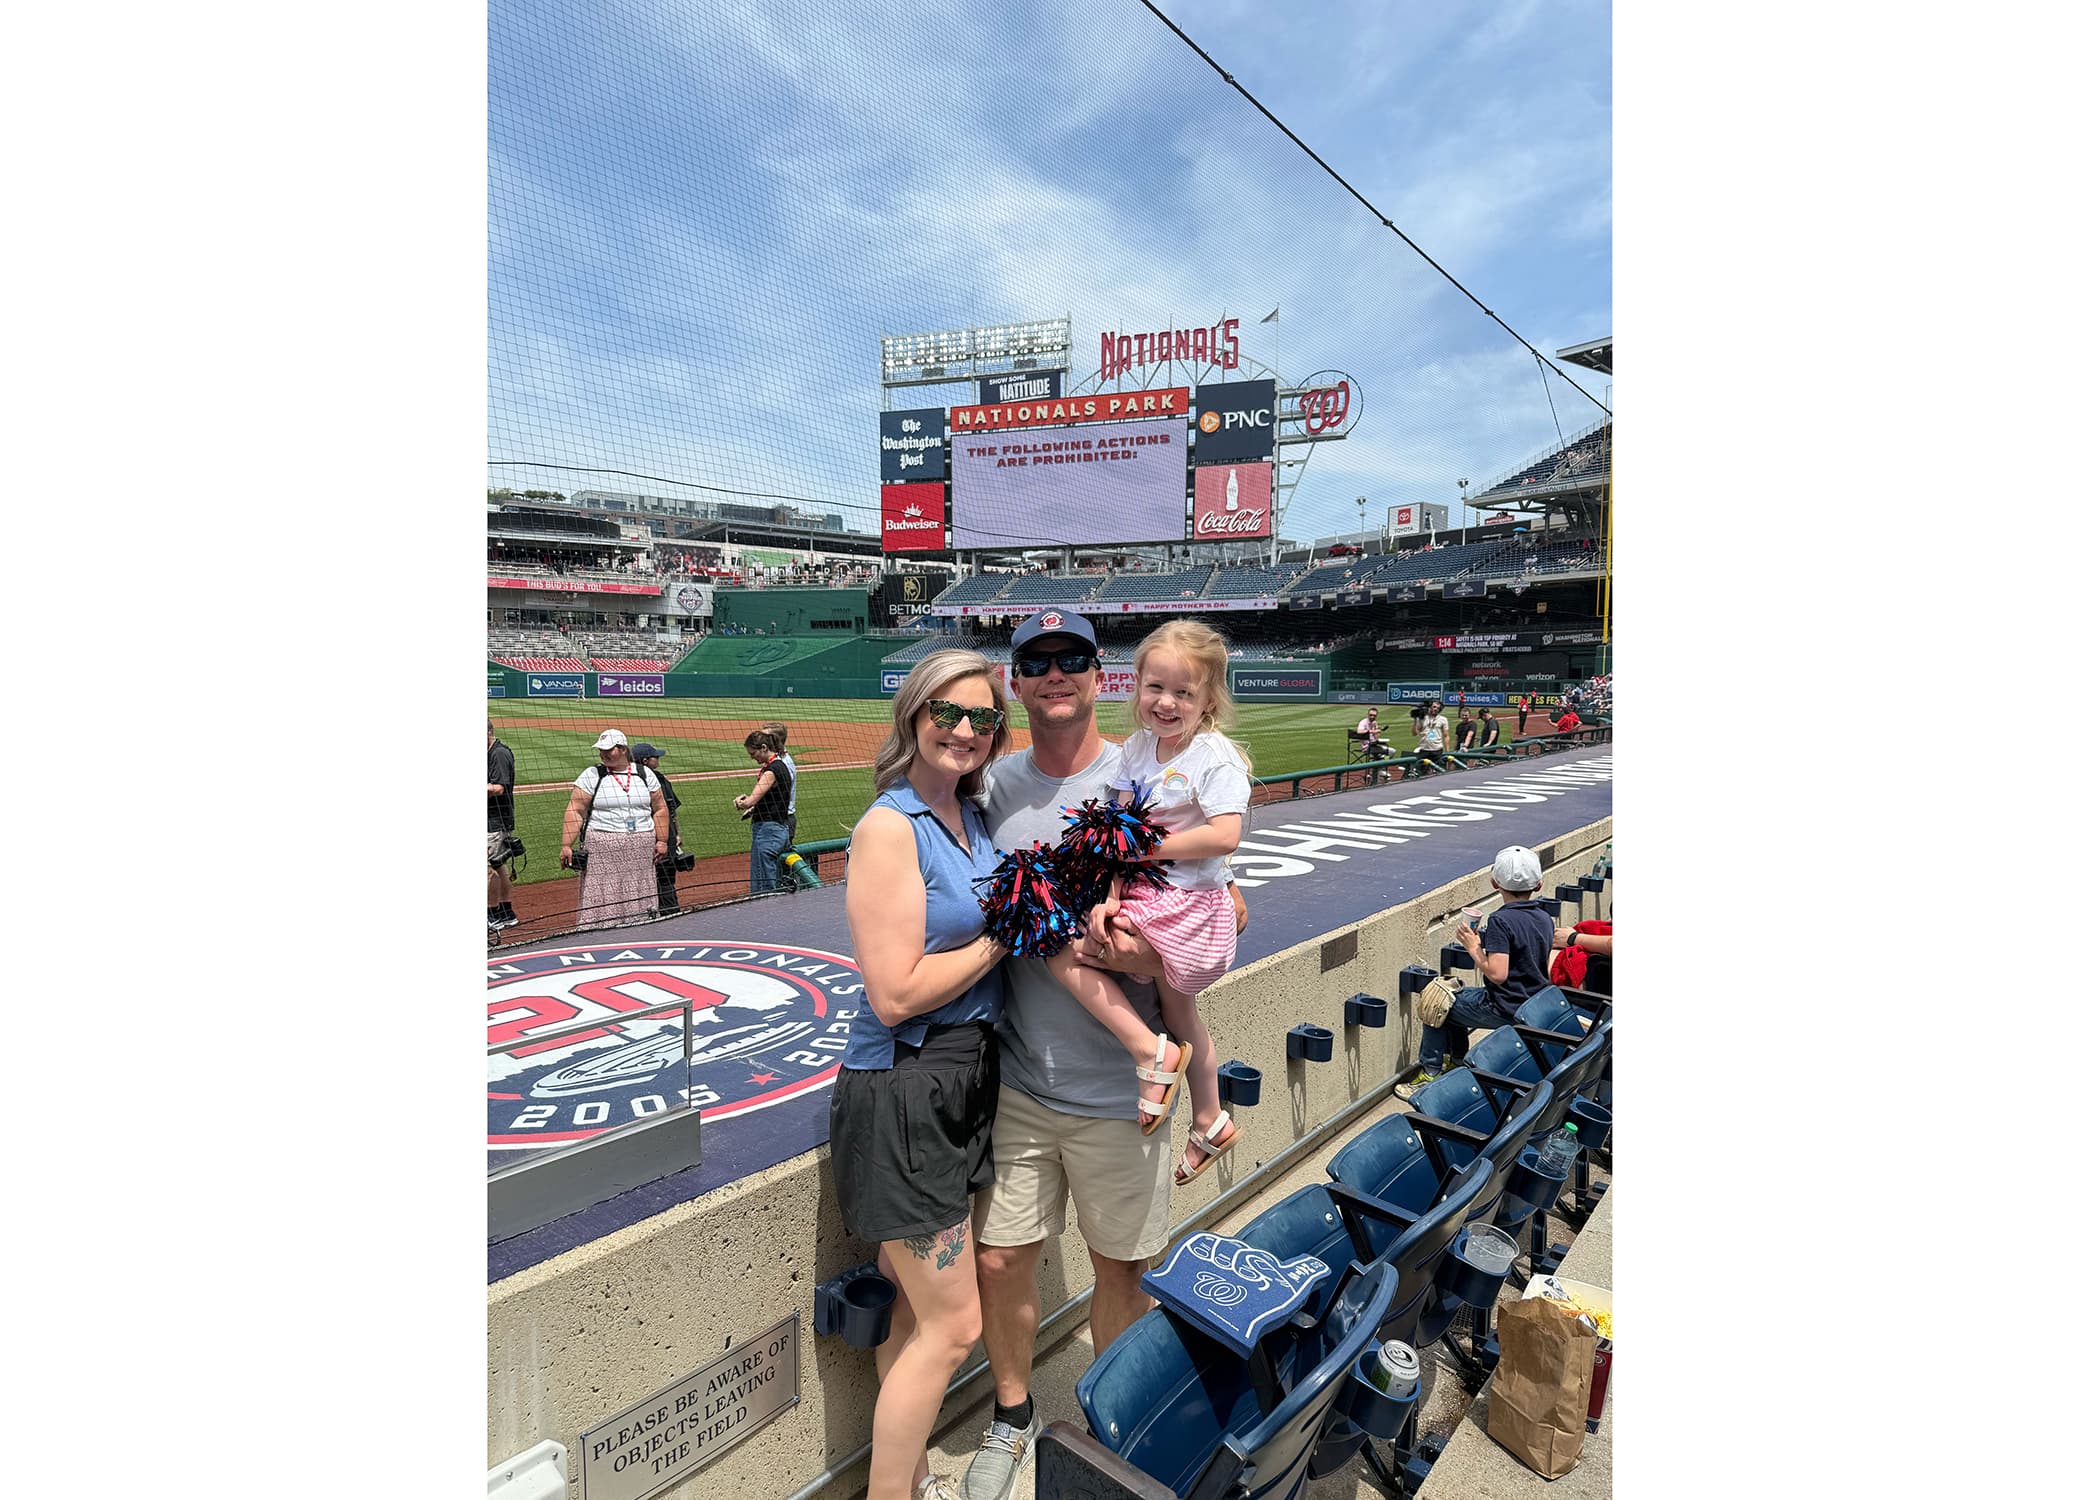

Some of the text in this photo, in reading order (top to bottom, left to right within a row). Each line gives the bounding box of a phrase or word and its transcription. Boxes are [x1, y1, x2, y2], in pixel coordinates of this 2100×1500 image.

[1101, 318, 1239, 381] NATIONALS
[989, 374, 1026, 386] SHOW SOME
[1000, 377, 1050, 401] NATITUDE
[958, 394, 1175, 426] NATIONALS PARK
[1223, 409, 1270, 429] PNC
[901, 419, 921, 433] The
[882, 435, 942, 451] Washington
[967, 434, 1170, 458] THE FOLLOWING ACTIONS
[900, 453, 924, 470] Post
[997, 451, 1138, 468] ARE PROHIBITED:
[885, 519, 940, 531] Budweiser
[1197, 508, 1266, 534] Coca-Cola
[526, 580, 543, 589] THIS
[545, 581, 568, 590] BUD'S
[570, 582, 585, 591] FOR
[889, 604, 931, 615] BETMG
[1438, 638, 1452, 647] 1:14
[1238, 679, 1315, 688] VENTURE GLOBAL
[1526, 672, 1556, 681] verizon
[619, 680, 662, 693] leidos
[1402, 690, 1440, 699] DABOS
[558, 947, 865, 996] NATIONALS
[487, 970, 732, 1059] 20
[509, 1083, 721, 1130] 2005
[1193, 1271, 1248, 1306] W
[592, 1334, 790, 1462] PLEASE BE AWARE OF
[613, 1365, 776, 1474] OBJECTS LEAVING
[651, 1405, 748, 1475] THE FIELD
